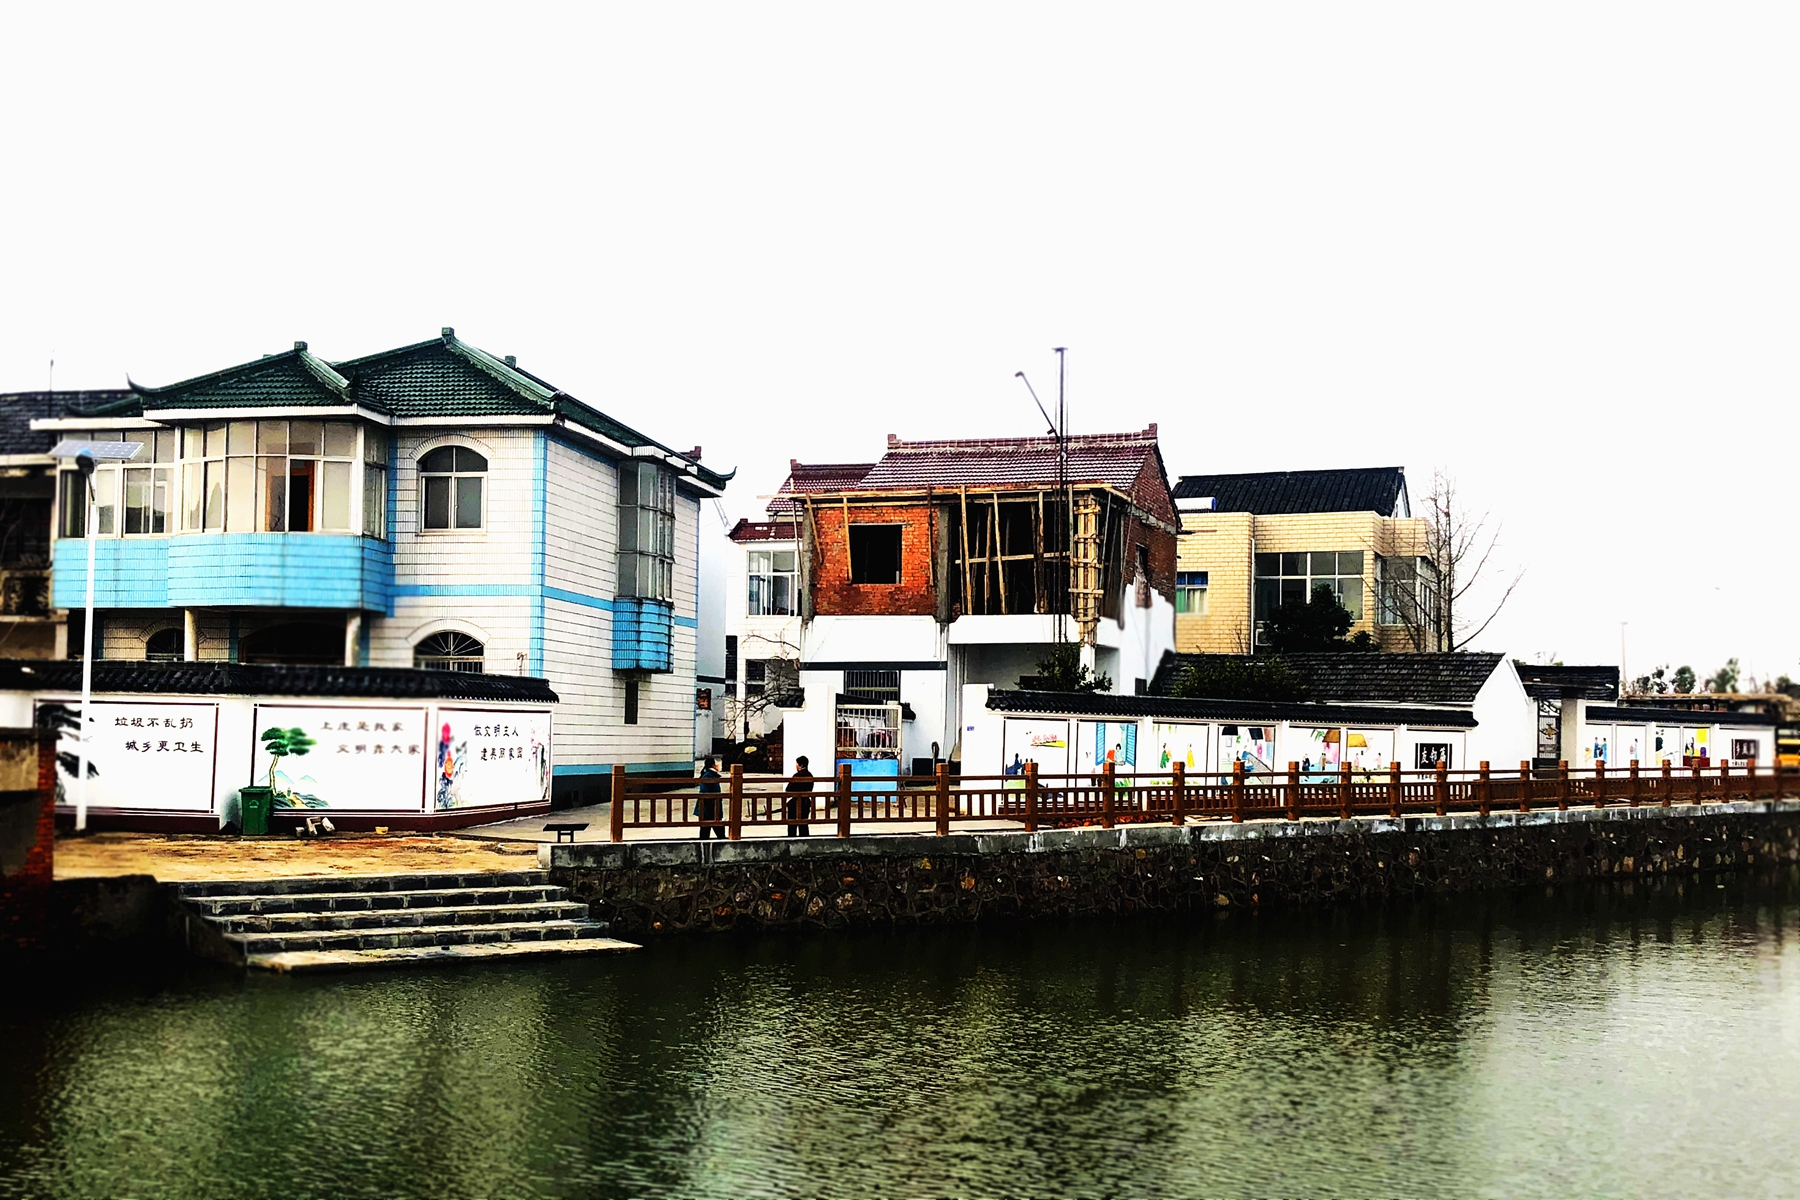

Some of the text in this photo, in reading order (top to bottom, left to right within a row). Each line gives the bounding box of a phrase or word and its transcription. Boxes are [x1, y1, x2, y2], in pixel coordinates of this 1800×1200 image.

[114, 716, 194, 730] 垃圾不乱扔
[125, 739, 204, 753] 城乡更卫生
